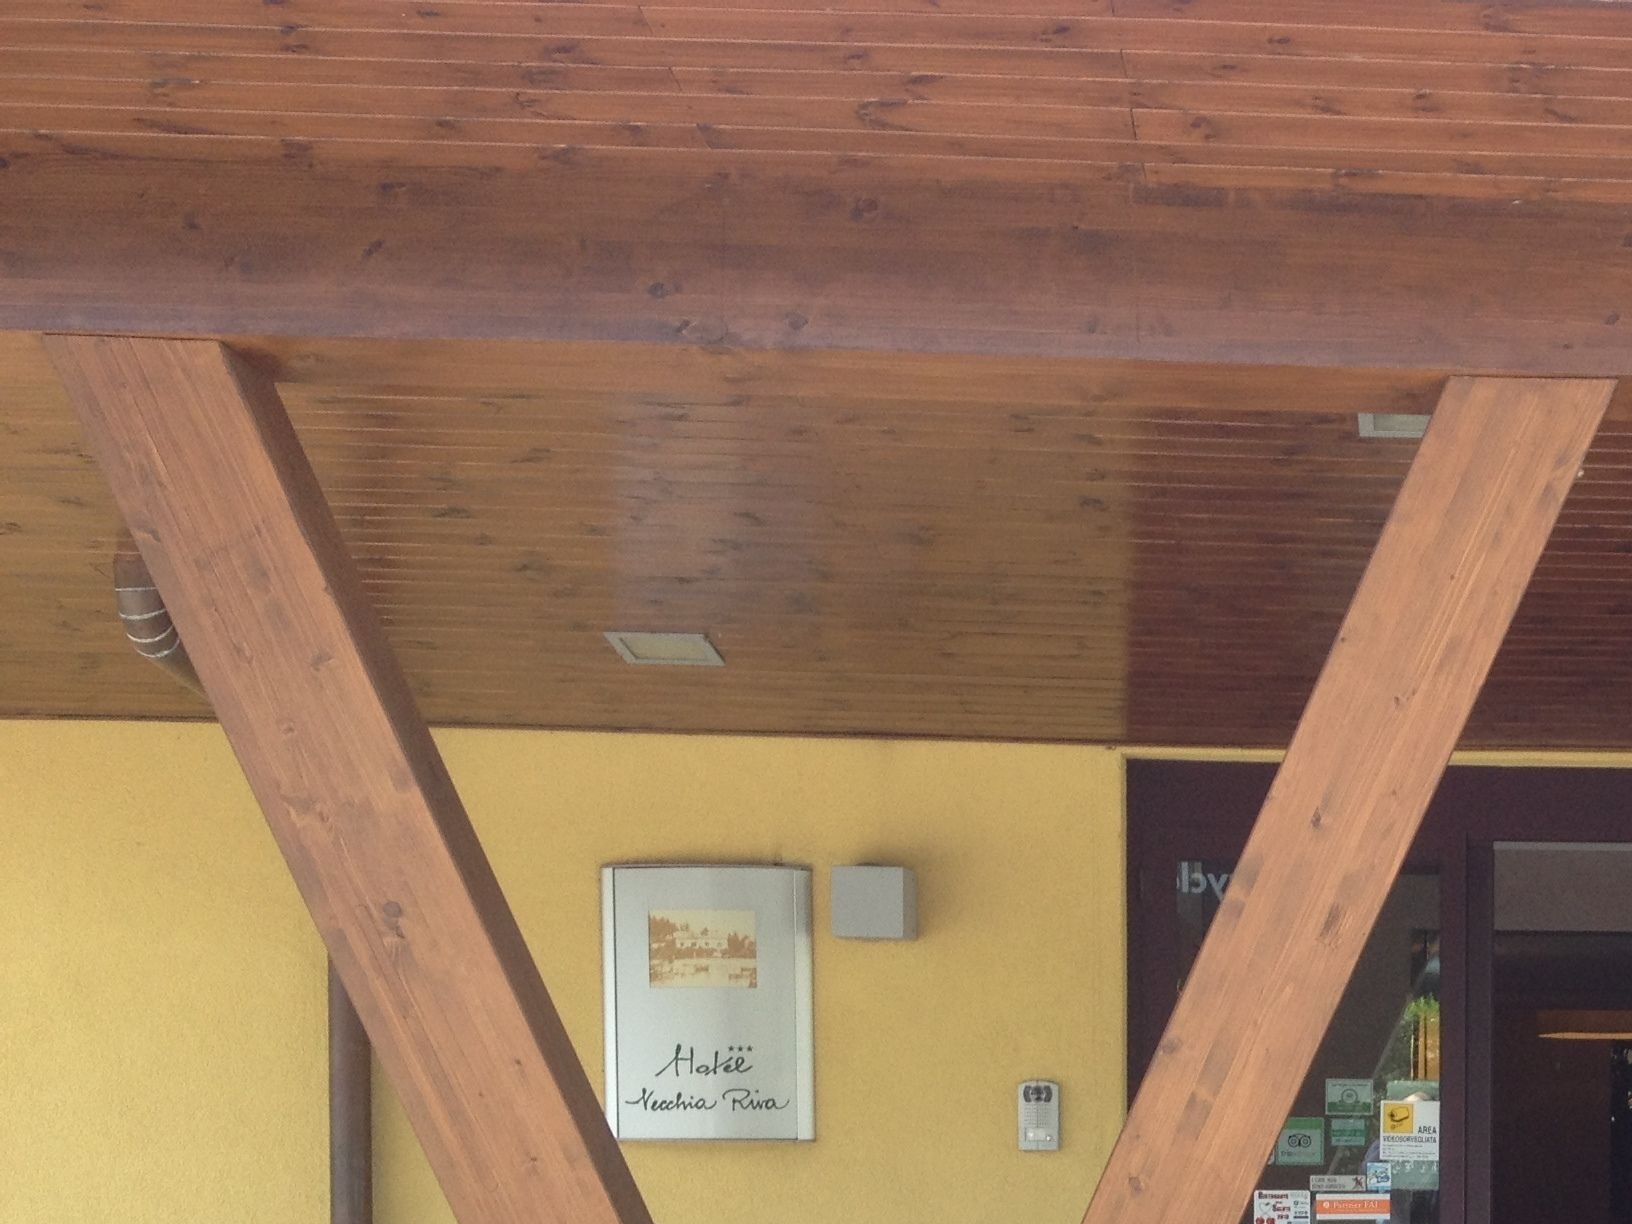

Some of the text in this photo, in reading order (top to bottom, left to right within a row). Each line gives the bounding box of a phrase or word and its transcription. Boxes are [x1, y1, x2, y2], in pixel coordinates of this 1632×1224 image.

[654, 1043, 753, 1077] Hotel
[624, 1087, 790, 1111] Vecchia Riva
[1418, 1126, 1437, 1134] AREA
